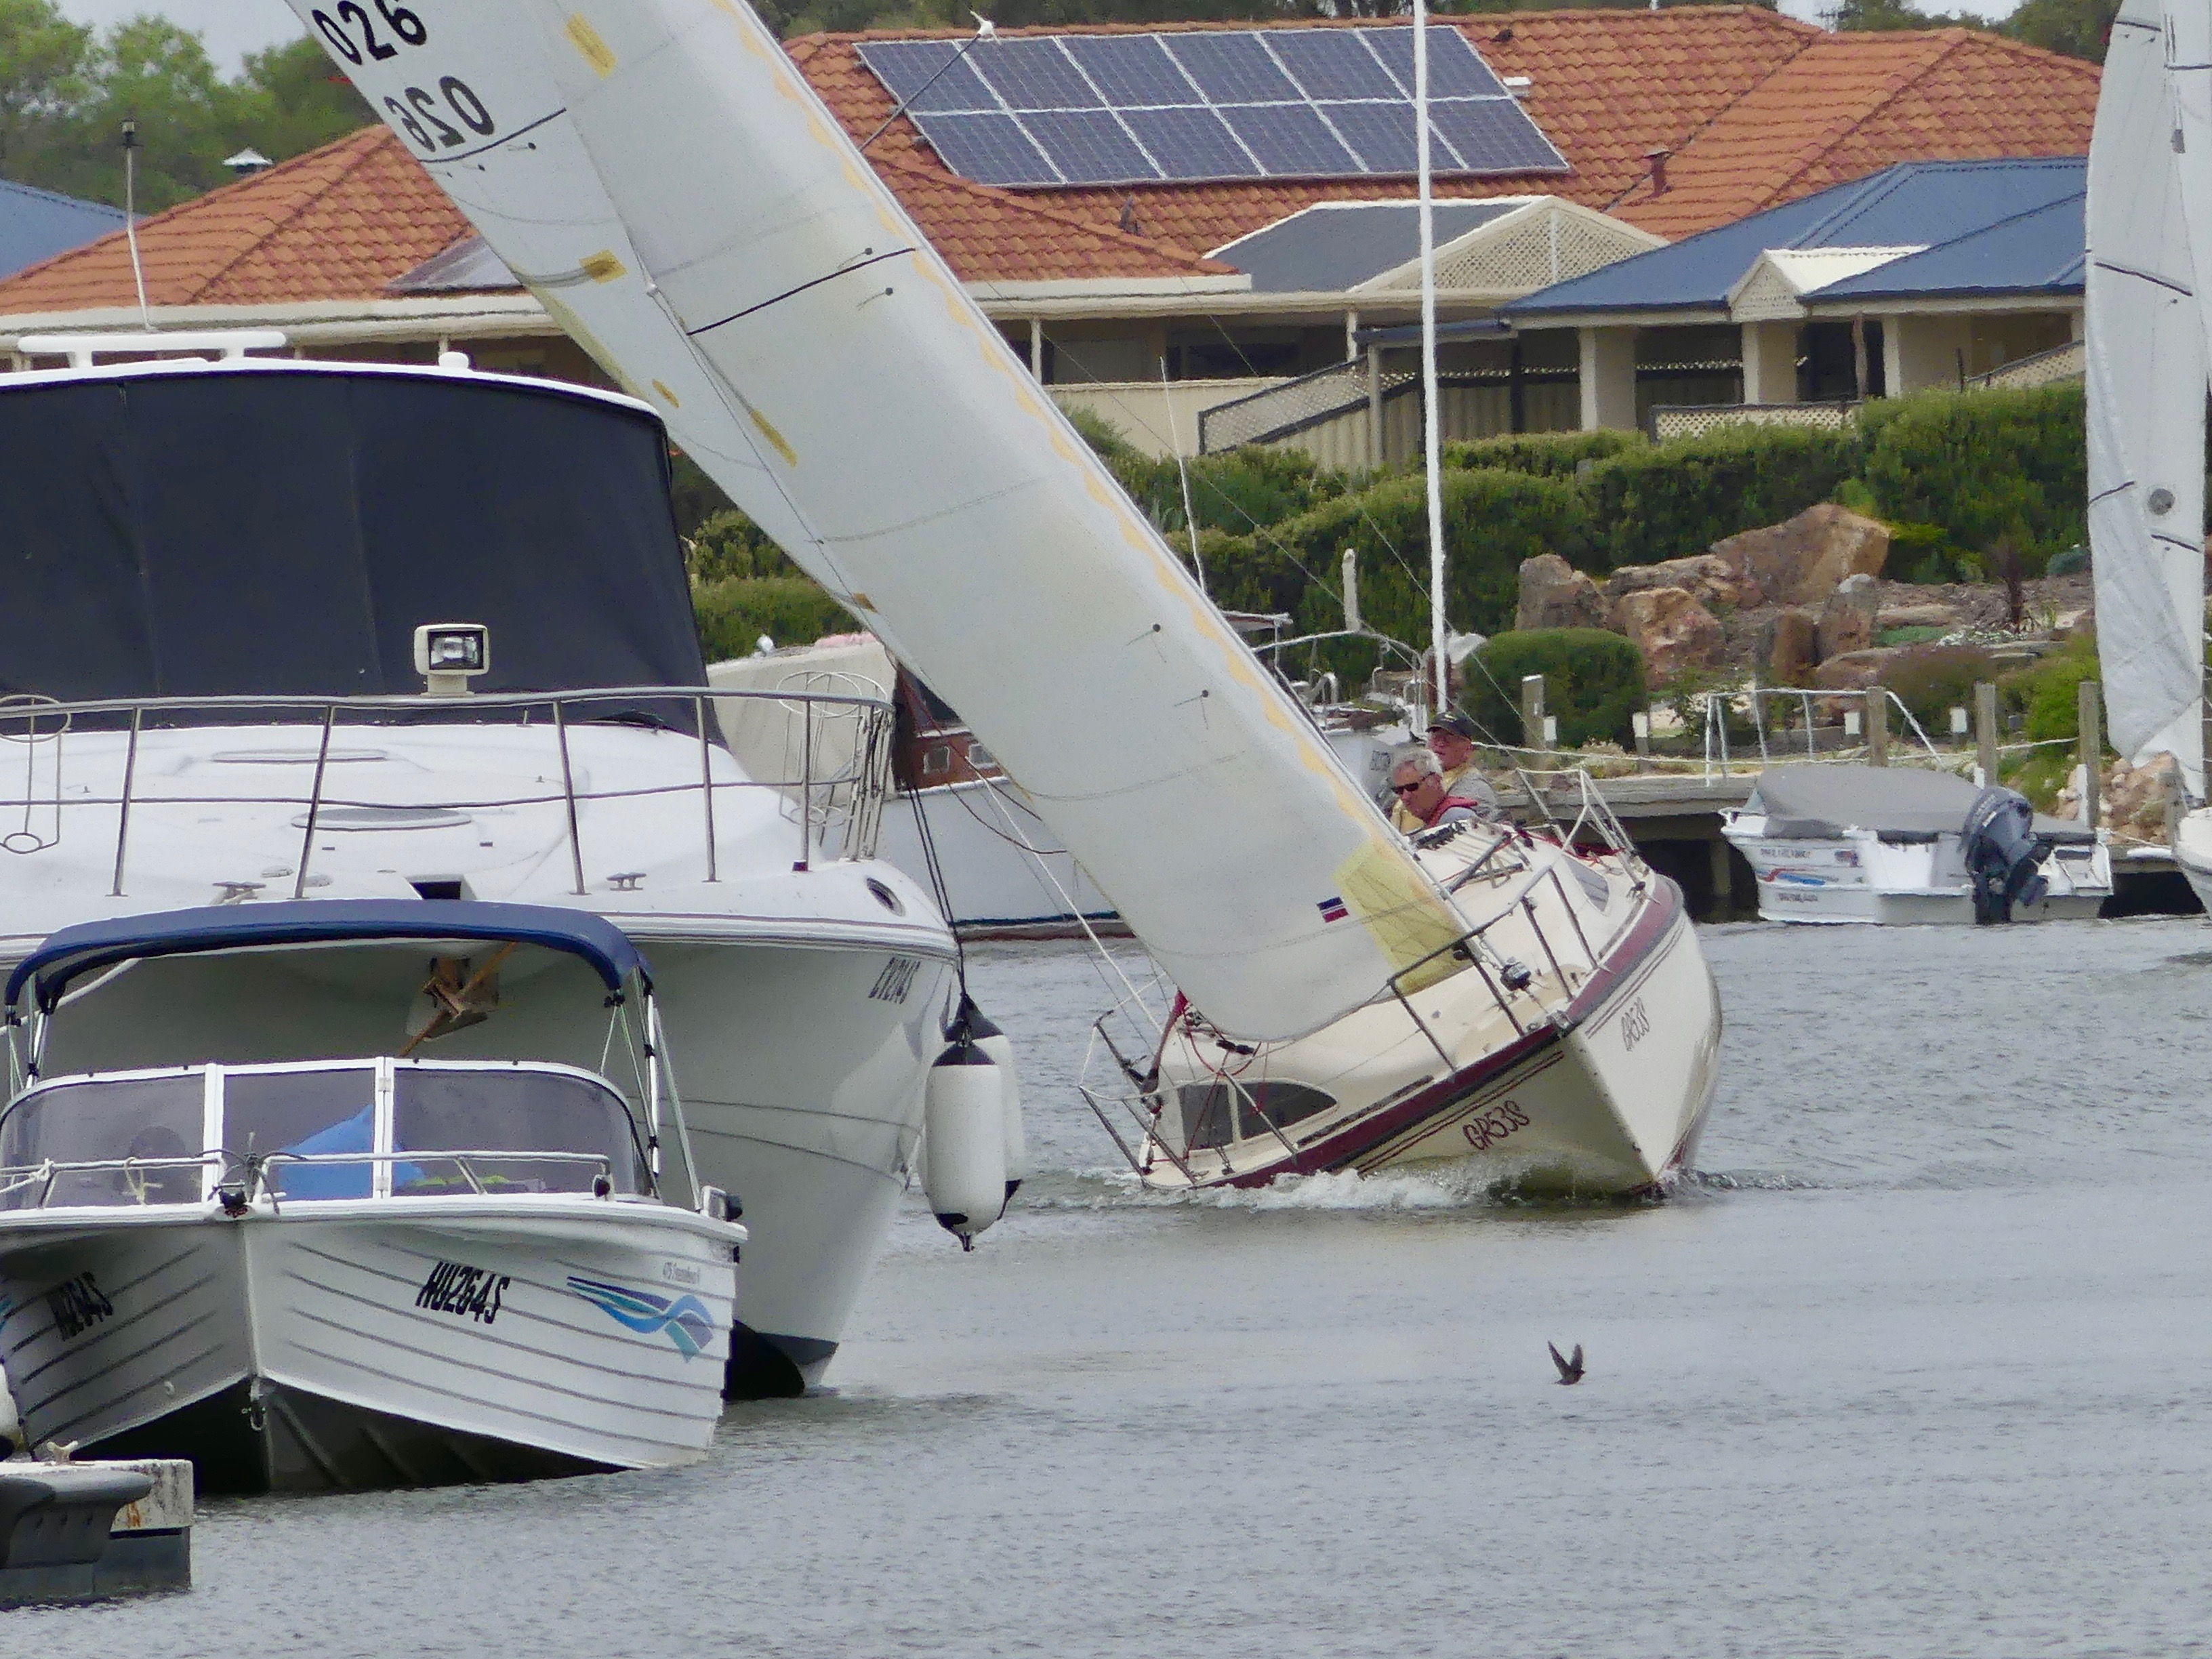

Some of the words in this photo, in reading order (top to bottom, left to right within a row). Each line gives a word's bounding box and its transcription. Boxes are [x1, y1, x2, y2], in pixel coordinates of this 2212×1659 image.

[311, 0, 427, 65] 026
[1462, 1100, 1530, 1151] GR53S
[415, 1261, 511, 1324] HU264S
